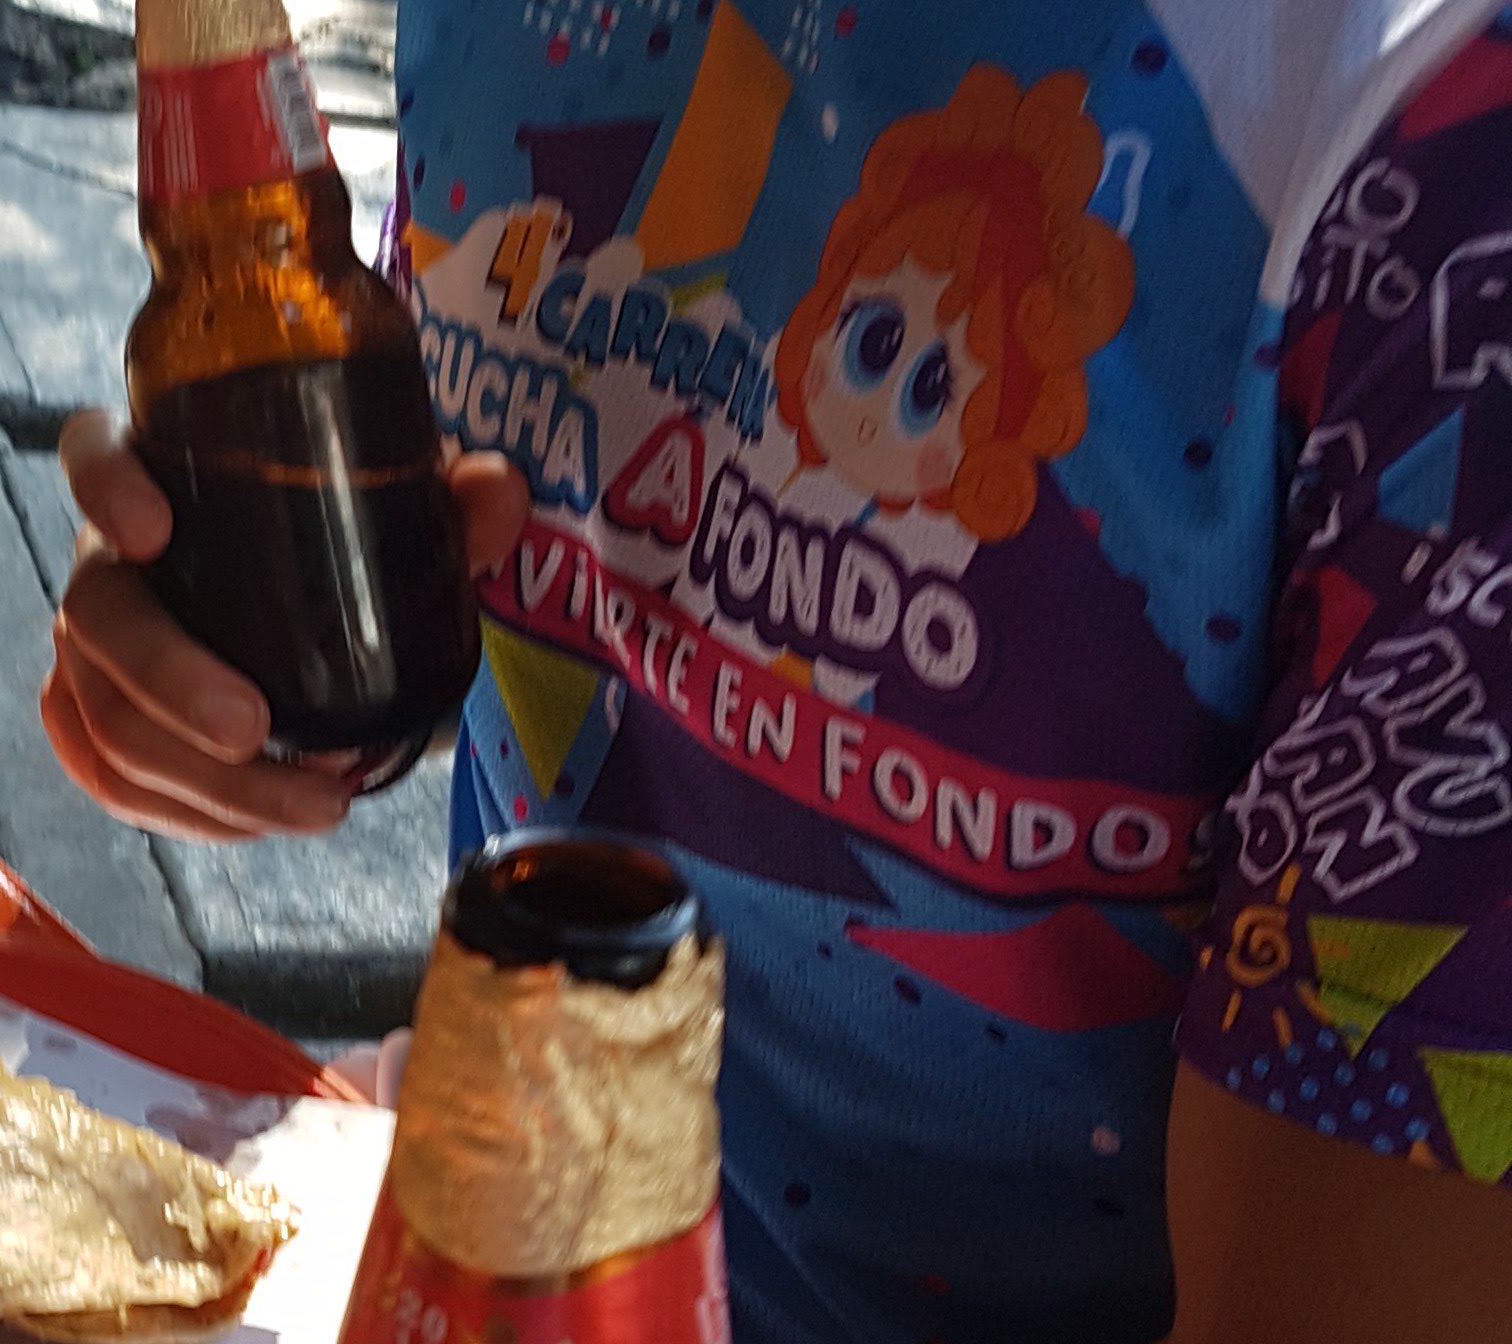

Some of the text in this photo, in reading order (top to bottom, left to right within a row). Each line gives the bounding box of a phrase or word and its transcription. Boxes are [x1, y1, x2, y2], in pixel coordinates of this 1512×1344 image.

[616, 421, 980, 691] A FONDO
[712, 659, 797, 763] EN
[821, 715, 1173, 873] FONDO
